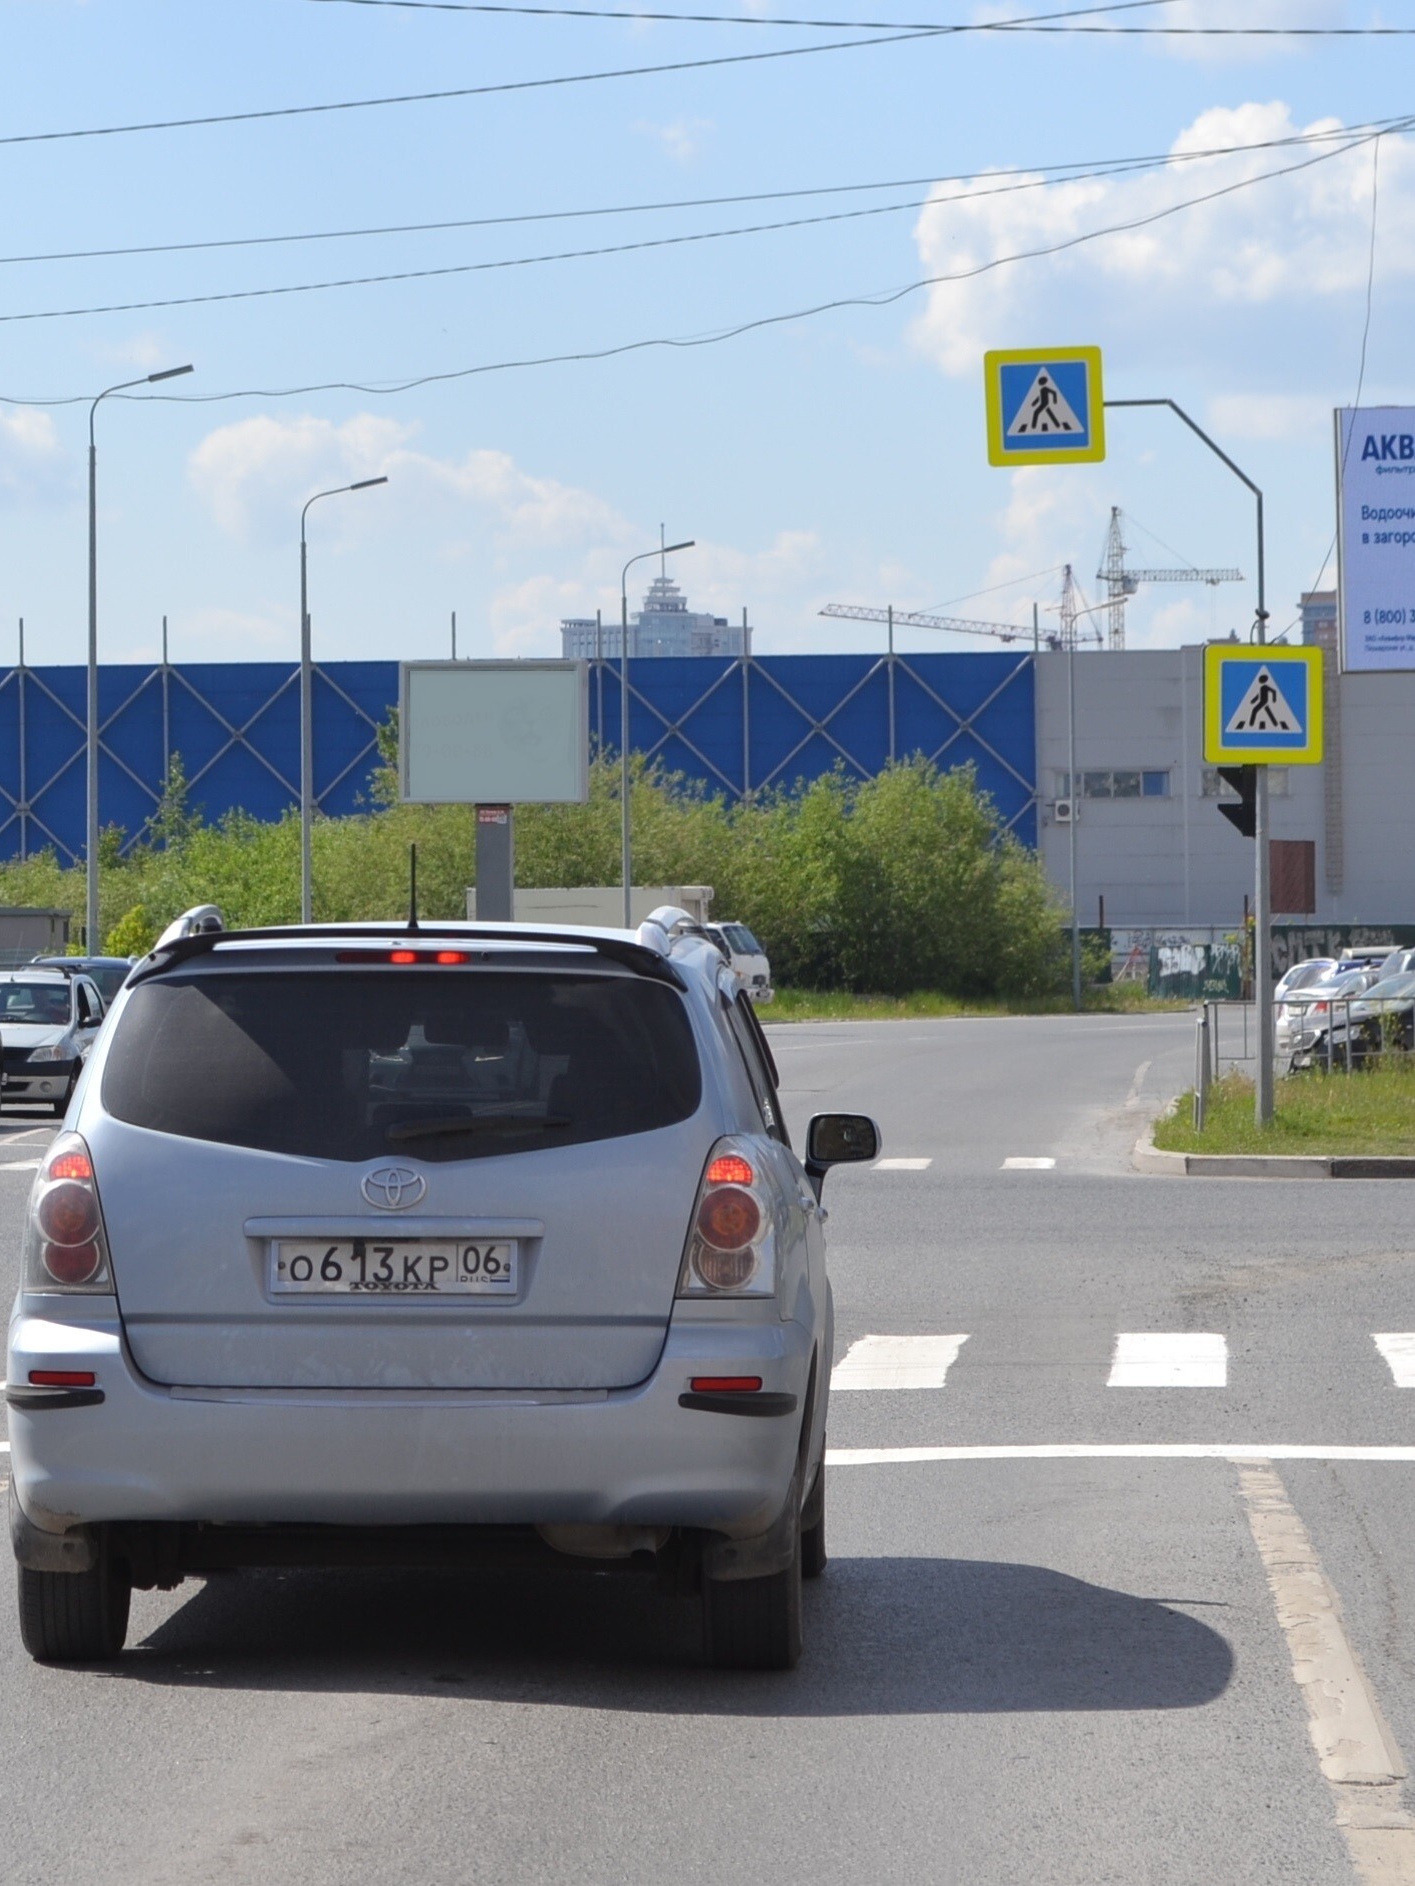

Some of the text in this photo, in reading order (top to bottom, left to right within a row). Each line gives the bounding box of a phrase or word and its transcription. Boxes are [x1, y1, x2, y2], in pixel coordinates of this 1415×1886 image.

[1362, 533, 1369, 544] в
[1364, 610, 1371, 624] 8
[1375, 607, 1406, 625] (800)
[463, 1246, 501, 1274] 06
[350, 1281, 442, 1291] TOYOTA
